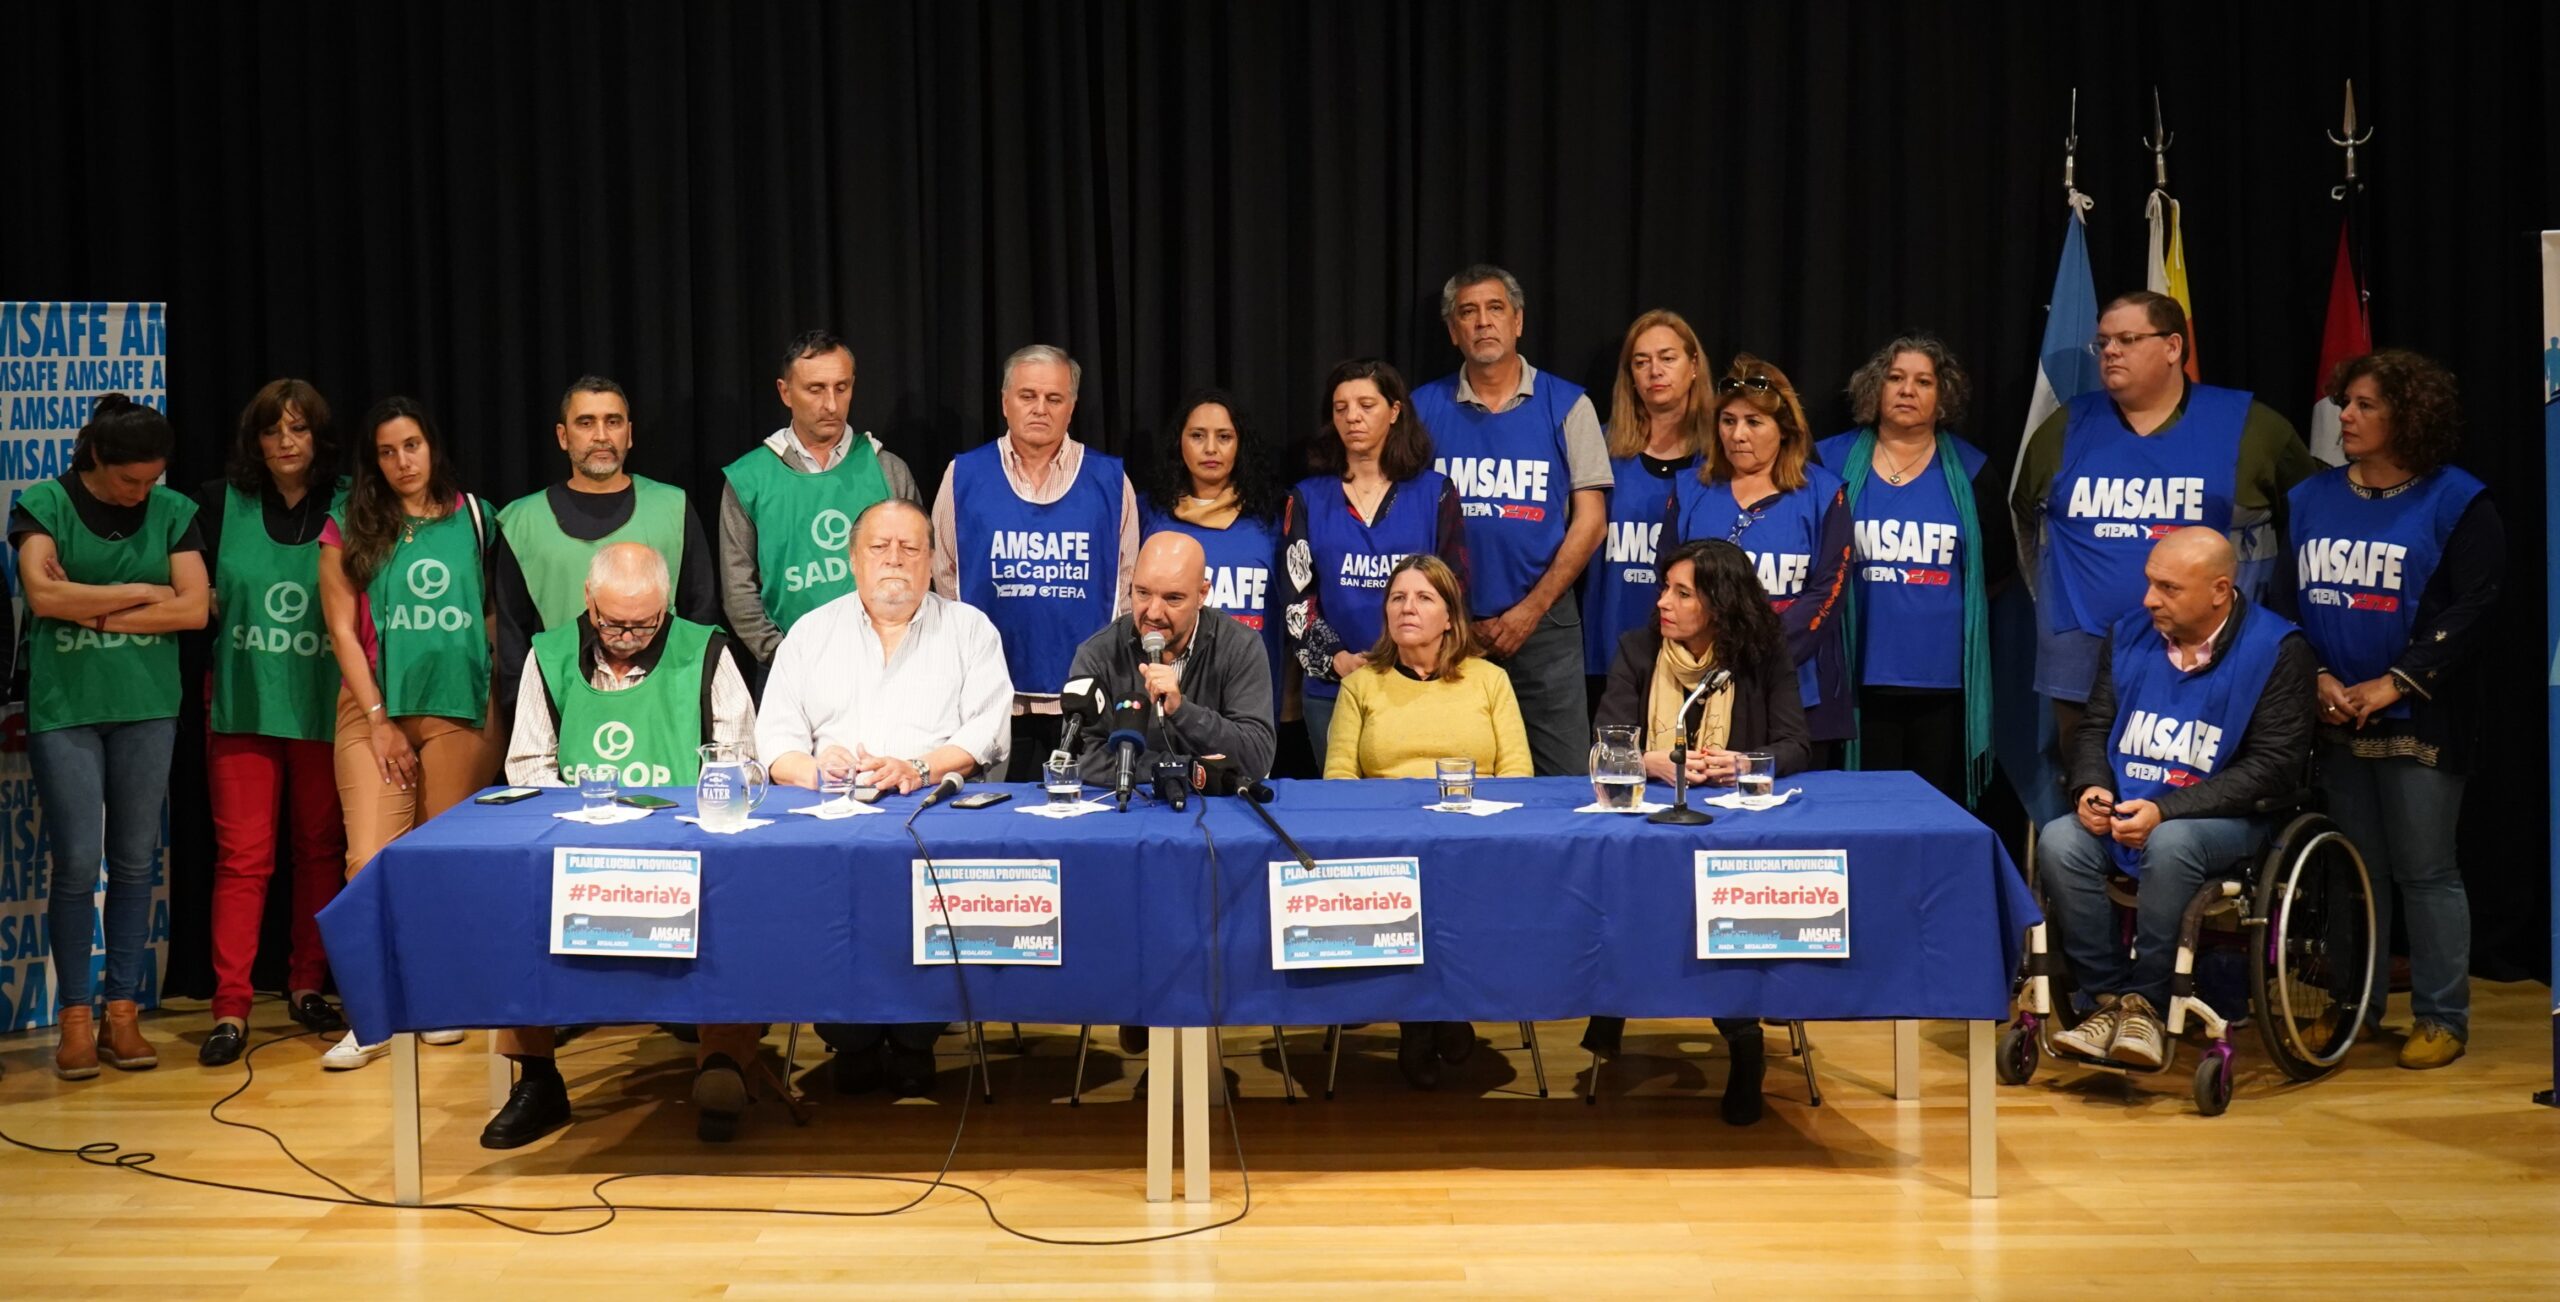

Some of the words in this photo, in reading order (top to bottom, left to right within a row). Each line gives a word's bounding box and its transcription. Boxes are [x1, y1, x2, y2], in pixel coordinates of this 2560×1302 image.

[65, 360, 144, 390] AMSAFE
[0, 438, 75, 480] MSAF
[2068, 477, 2205, 520] AMSAFE
[990, 530, 1090, 561] AMSAFE
[1605, 521, 1664, 564] AMS
[1853, 519, 1958, 565] MSAFE
[992, 561, 1090, 583] LaCapital
[1746, 551, 1811, 596] AFE
[2298, 537, 2408, 591] AMSAFE
[784, 557, 855, 592] SAD
[1340, 577, 1360, 587] SAN
[1361, 579, 1388, 588] JERO
[1039, 586, 1087, 599] CTERA
[1203, 566, 1269, 609] SAFE
[702, 787, 730, 800] WATER
[606, 857, 636, 871] LUCHA
[637, 858, 693, 871] PROVINCIAL
[966, 868, 996, 880] LUCHA
[997, 867, 1052, 880] PROVINCIAL
[1322, 865, 1353, 878] LUCHA
[1354, 863, 1411, 877] PROVINCIAL
[1750, 859, 1781, 871] LUCHA
[1781, 858, 1839, 871] PROVINCIAL
[569, 884, 691, 905] #ParitariaYa
[929, 894, 1052, 913] #ParitariaYa
[1286, 891, 1412, 913] #ParitariaYa
[1711, 886, 1839, 905] #ParitariaYa
[649, 927, 691, 942] AMSAFE
[1013, 935, 1054, 949] AMSAFE
[1373, 932, 1416, 948] AMSAFE
[1798, 928, 1841, 942] AMSAFE
